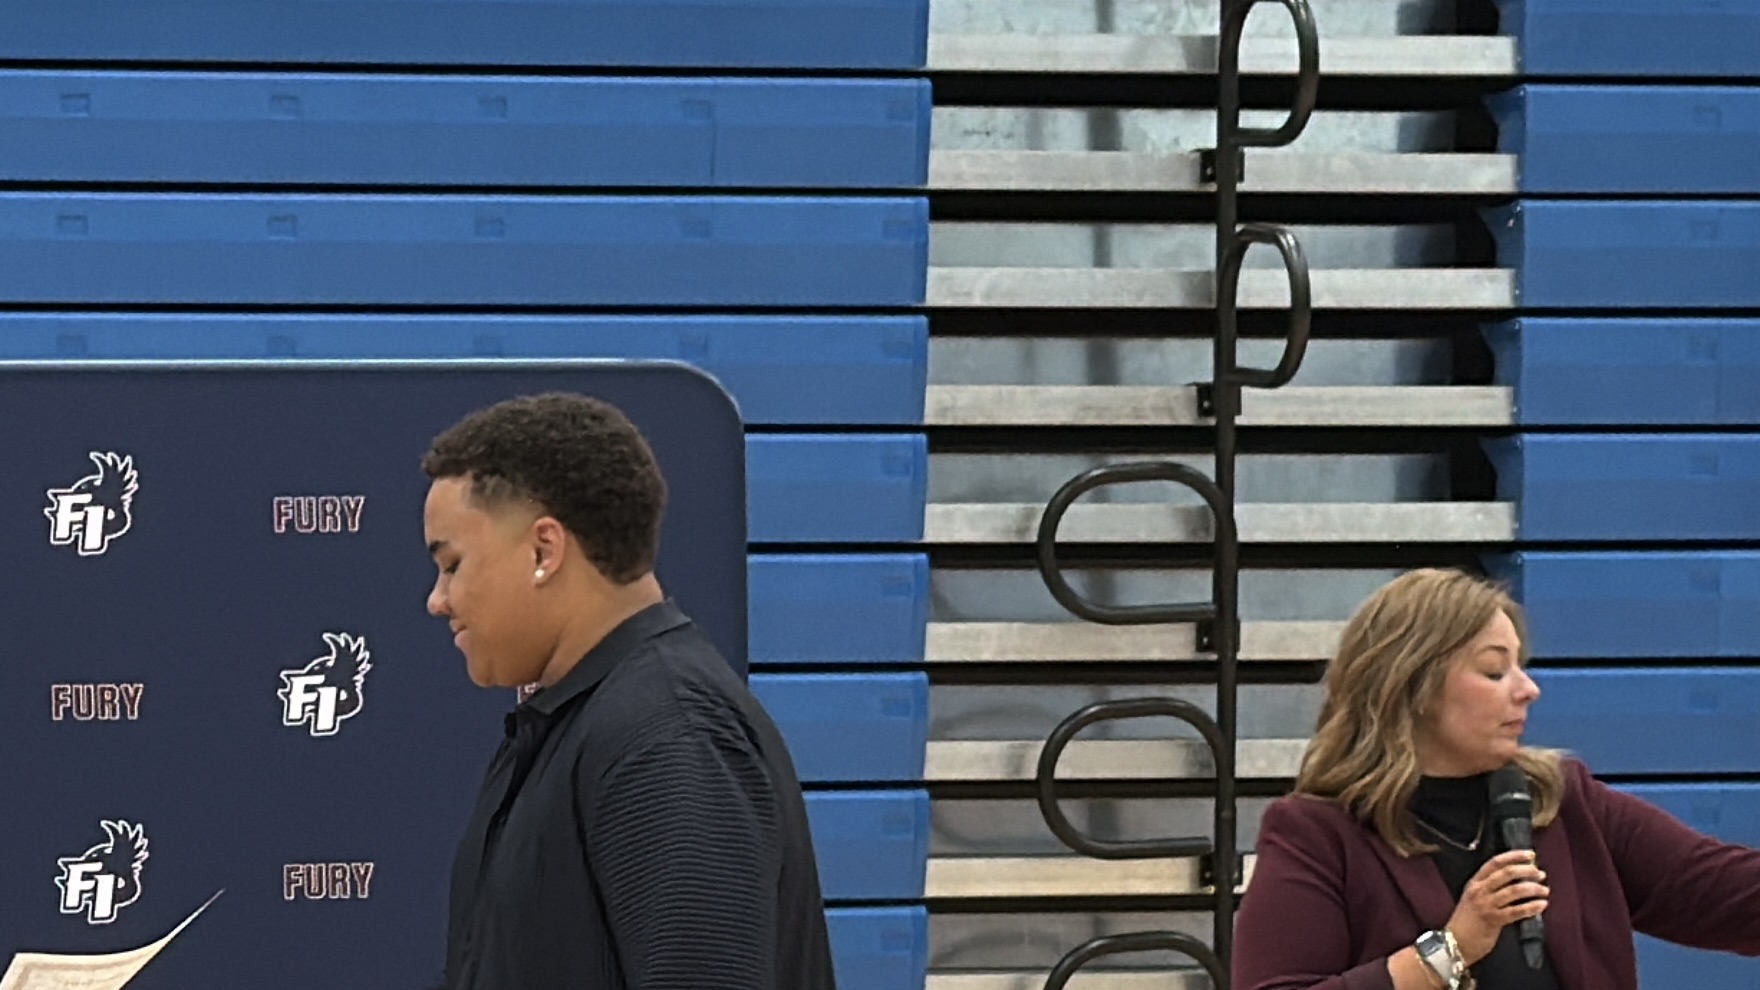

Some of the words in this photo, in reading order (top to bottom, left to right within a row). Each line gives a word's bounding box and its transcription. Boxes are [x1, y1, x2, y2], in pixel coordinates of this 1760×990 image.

[272, 496, 365, 533] FURY
[51, 683, 144, 721] FURY
[283, 862, 375, 900] FURY
